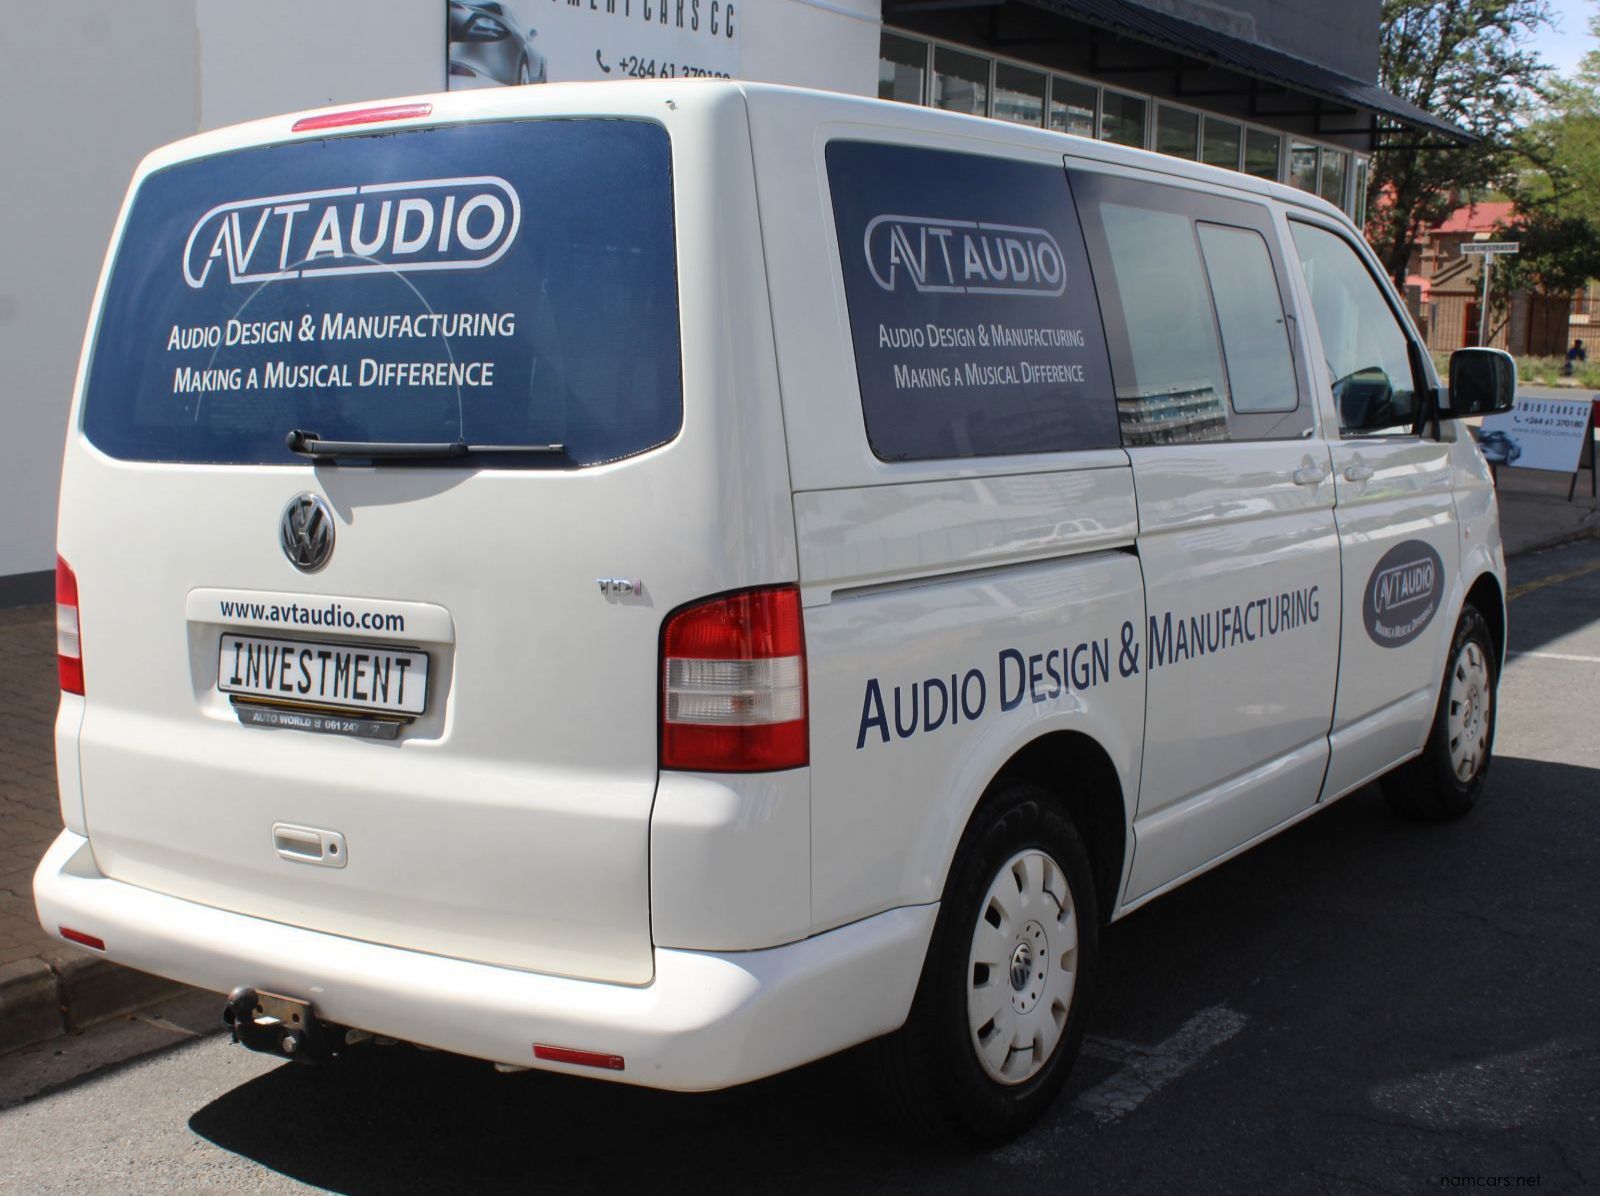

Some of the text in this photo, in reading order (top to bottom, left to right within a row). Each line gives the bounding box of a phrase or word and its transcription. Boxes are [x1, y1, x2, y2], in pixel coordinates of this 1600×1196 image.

[644, 0, 698, 31] CARS
[711, 0, 734, 39] CC
[619, 56, 655, 78] +264
[660, 62, 675, 78] 61
[305, 193, 504, 262] AUDIO
[963, 235, 1059, 284] AUDIO
[168, 312, 515, 351] AUDIO DESIGN & MANUFACTURING
[879, 323, 1085, 348] AUDIO DESIGN & MANUFACTURING
[173, 358, 495, 393] MAKING A MUSICAL DIFFERENCE
[894, 362, 1085, 389] MAKING A MUSICAL DIFFERENCE
[1401, 565, 1432, 598] AUDIO
[220, 600, 405, 631] www.avtaudio.com
[230, 642, 411, 705] INVESTMENT
[856, 667, 987, 750] AUDIO
[998, 637, 1110, 713] DESIGN
[1118, 620, 1140, 678] &
[1148, 585, 1320, 670] MANUFACTURING
[253, 712, 277, 723] AUTO
[280, 715, 311, 727] WORLD
[325, 720, 341, 731] 061
